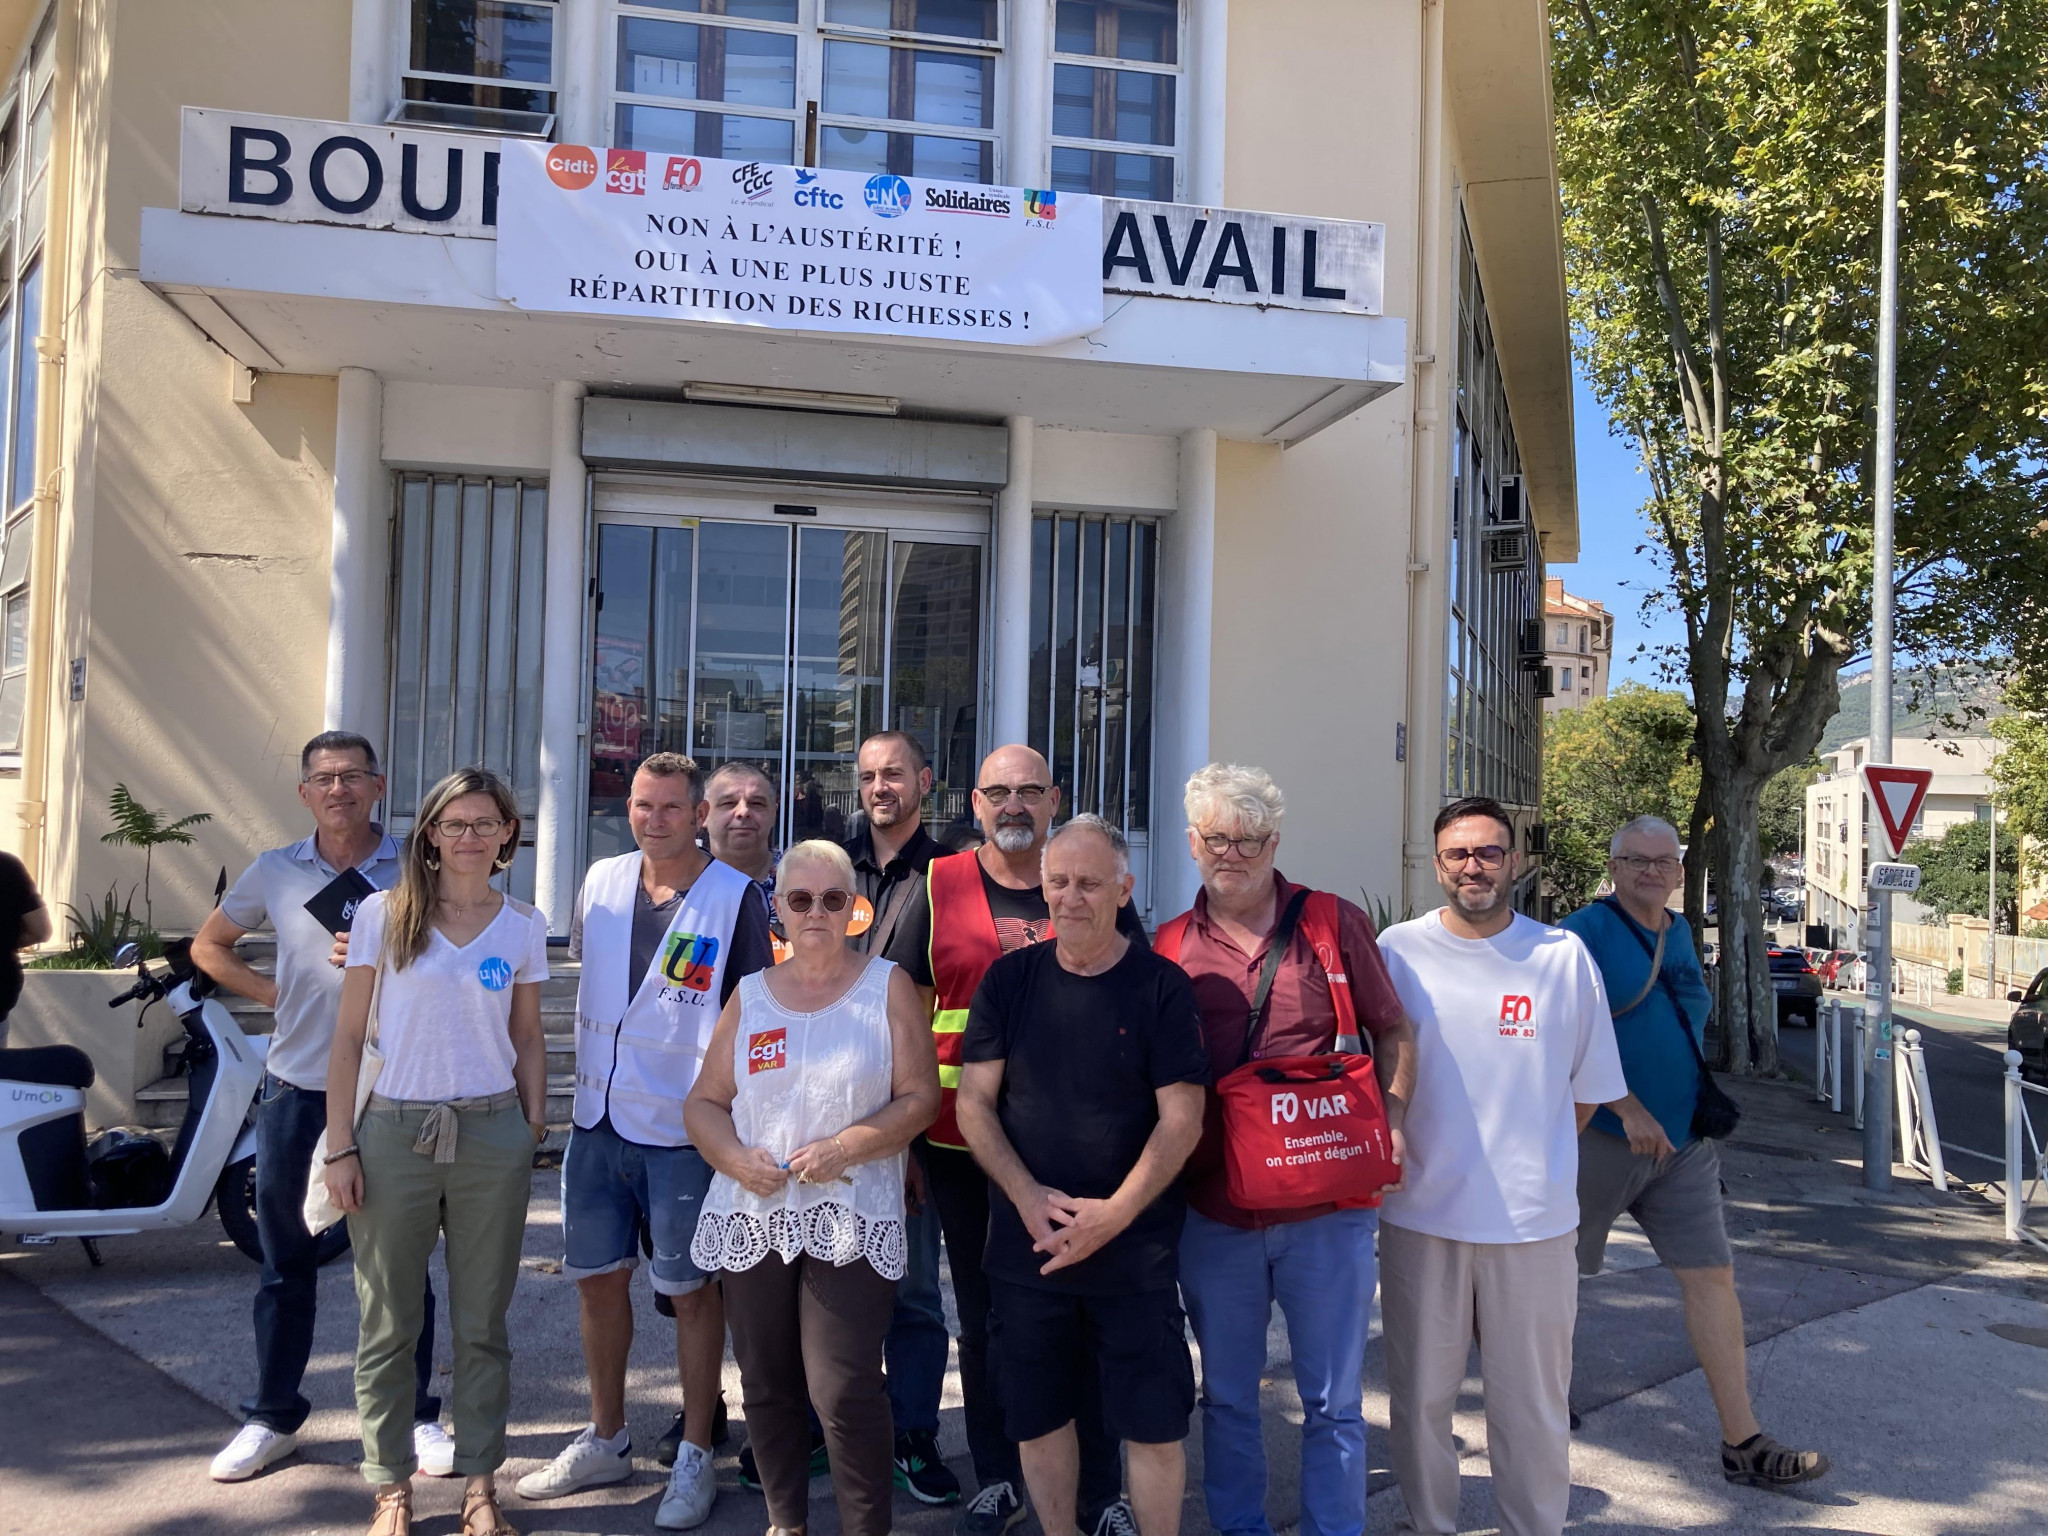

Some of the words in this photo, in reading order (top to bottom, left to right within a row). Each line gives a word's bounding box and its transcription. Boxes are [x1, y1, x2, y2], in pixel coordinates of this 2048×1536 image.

[229, 125, 501, 225] BOU
[606, 168, 646, 193] cgt
[663, 157, 702, 190] FO
[732, 162, 760, 184] CFE
[743, 170, 773, 195] CGC
[794, 186, 844, 210] cftc
[925, 187, 1011, 214] Solidaires
[646, 213, 709, 238] NON
[720, 215, 739, 240] À
[1025, 219, 1055, 230] F.S.U.
[635, 249, 689, 273] OUI
[700, 250, 719, 275] À
[731, 257, 789, 281] UNE
[801, 263, 873, 288] PLUS
[883, 270, 970, 296] JUSTE
[569, 274, 776, 313] RÉPARTITION
[788, 295, 842, 319] DES
[853, 300, 1012, 329] RICHESSES
[1877, 878, 1913, 888] PAGE
[1880, 867, 1905, 877] CÉZ
[1906, 870, 1915, 878] LE
[658, 987, 705, 1007] F.S.U.
[1499, 995, 1532, 1023] FO
[1499, 1028, 1518, 1036] VAR
[1523, 1029, 1534, 1037] 83
[750, 1038, 785, 1060] cgt
[757, 1061, 778, 1070] VAR
[1271, 1092, 1299, 1125] FO
[1303, 1094, 1350, 1120] VAR
[1284, 1130, 1348, 1150] Ensemble,
[1265, 1155, 1283, 1167] on
[1285, 1151, 1322, 1166] craint
[1324, 1144, 1363, 1160] dégun
